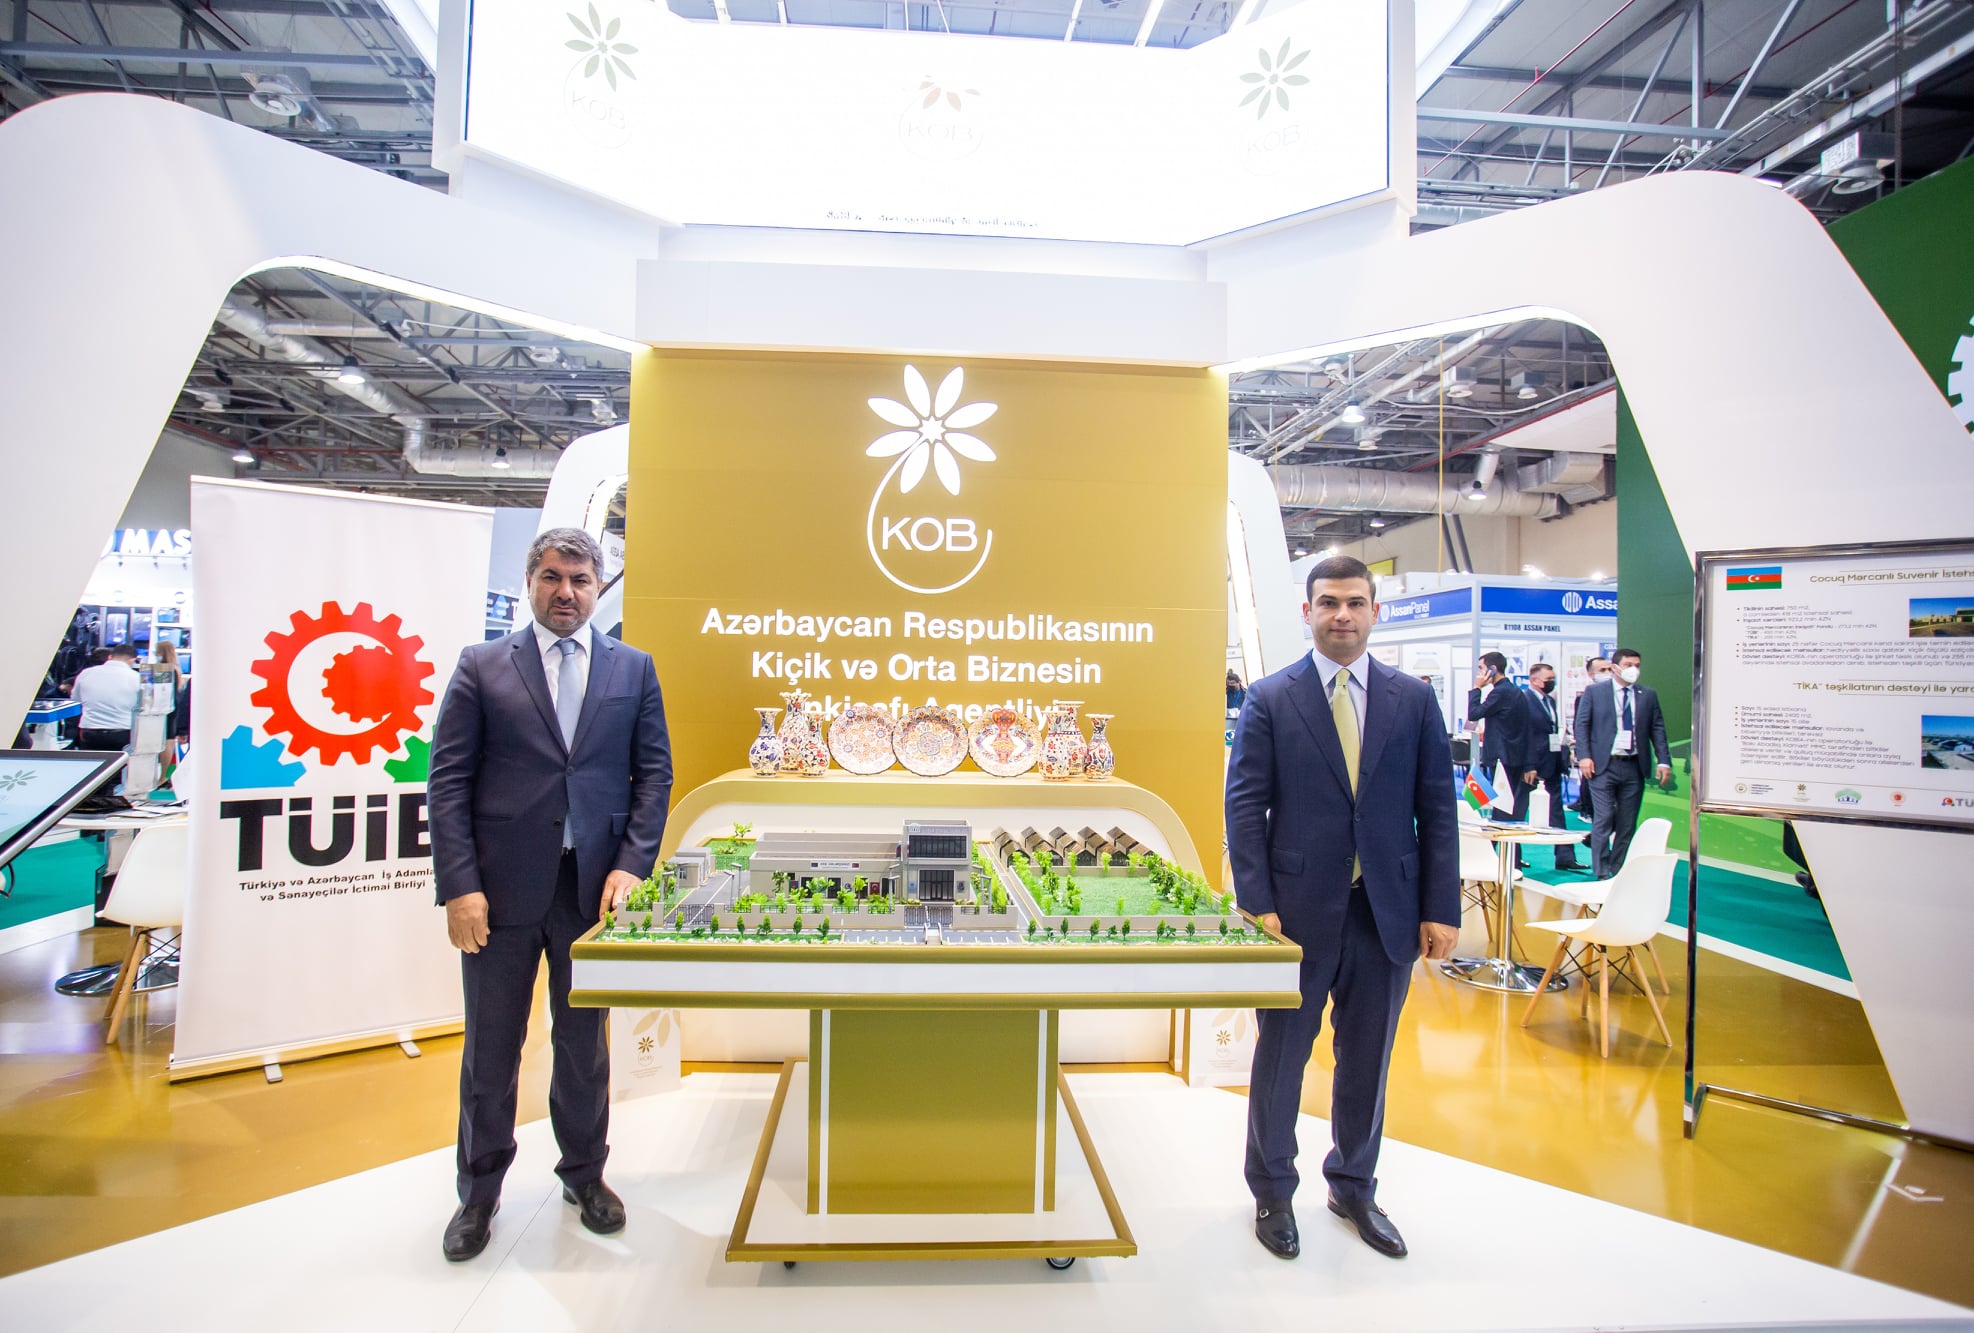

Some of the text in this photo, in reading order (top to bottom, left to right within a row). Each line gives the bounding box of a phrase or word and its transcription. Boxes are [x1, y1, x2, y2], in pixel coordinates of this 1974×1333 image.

[882, 517, 978, 552] KOB
[1897, 570, 1938, 580] Suvenir
[1390, 600, 1430, 617] AssanPanel
[701, 608, 1154, 645] Azərbaycan Respublikasının
[752, 652, 1102, 686] Kiçik və Orta Biznesin
[239, 880, 286, 891] Türkiyə
[290, 879, 304, 887] və
[307, 872, 375, 885] Azərbaycan
[382, 869, 392, 880] İş
[260, 879, 426, 901] və Sənayeçilər İctimai Birliyi
